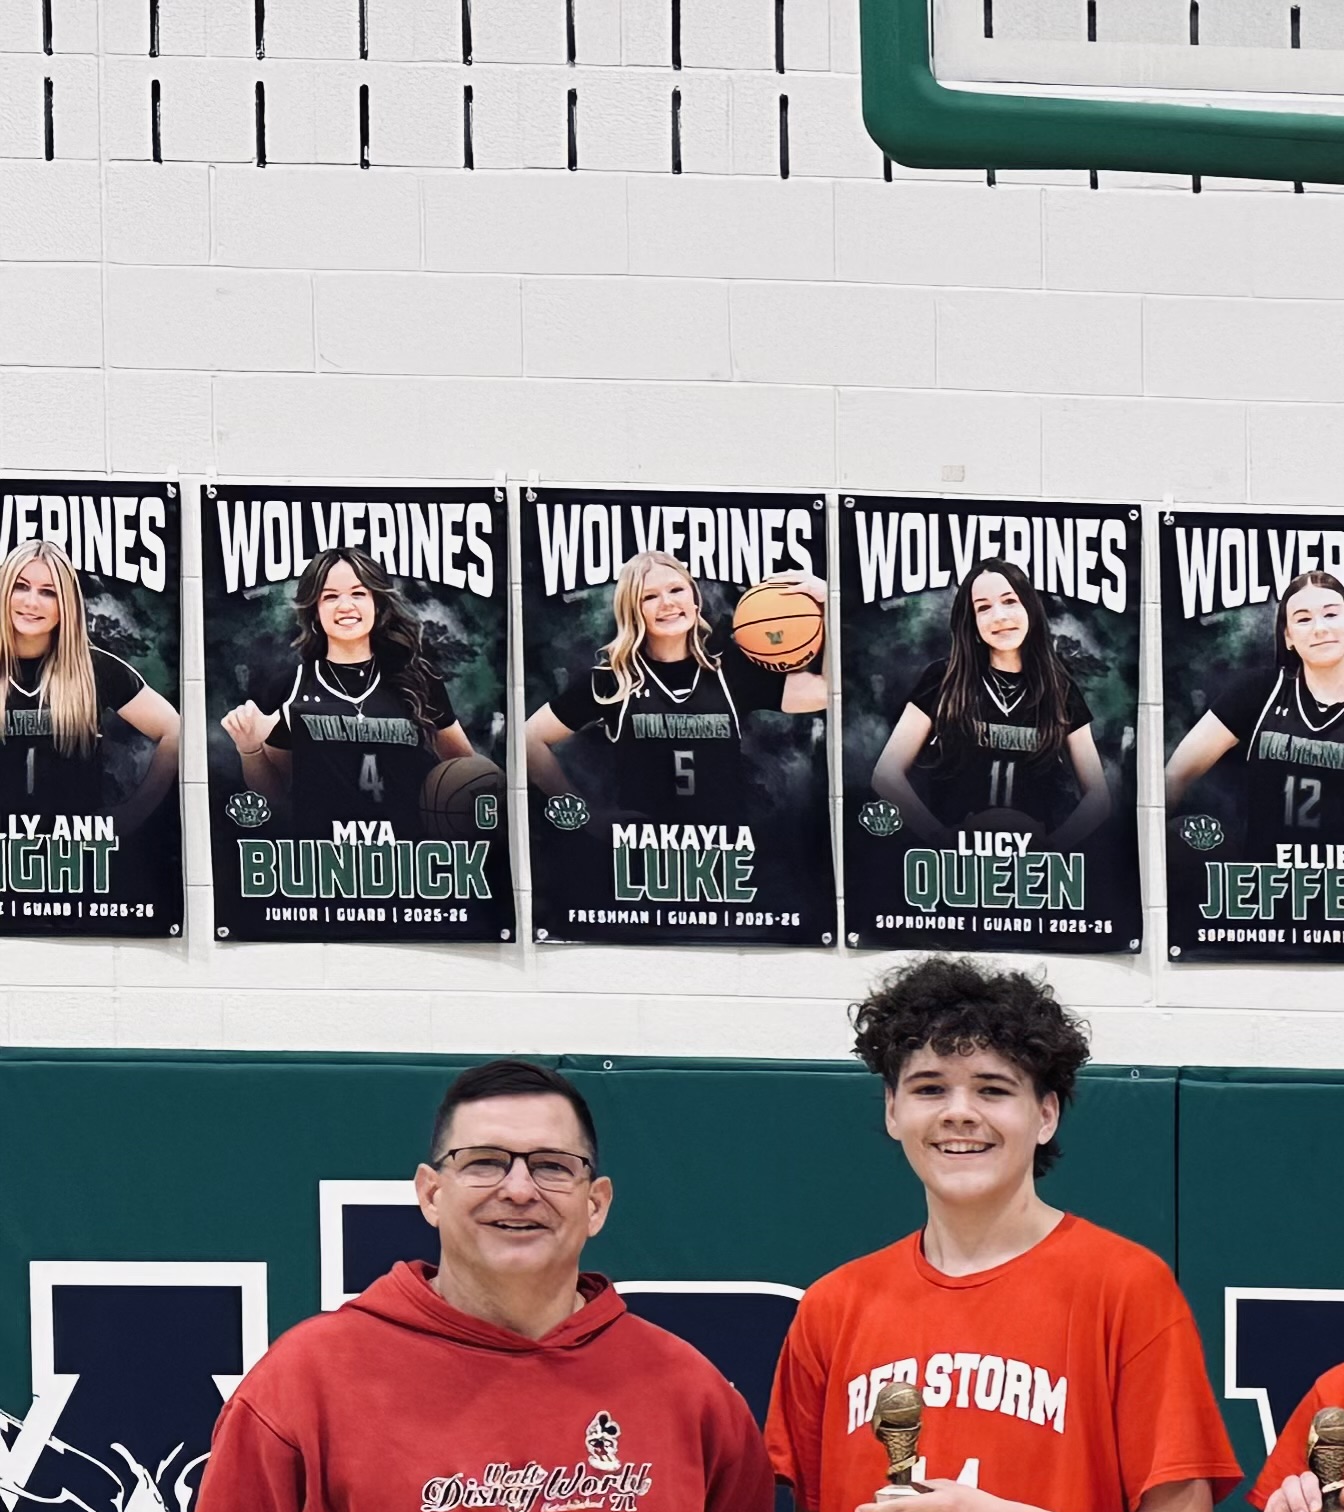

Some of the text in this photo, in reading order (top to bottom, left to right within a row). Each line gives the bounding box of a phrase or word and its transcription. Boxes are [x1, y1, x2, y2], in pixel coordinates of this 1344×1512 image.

[216, 501, 495, 598] WOLVERINES
[537, 503, 813, 596] WOLVERINES
[855, 511, 1127, 613] WOLVERINES
[359, 754, 384, 801] 4
[673, 750, 696, 796] 5
[989, 761, 1015, 806] 11
[1284, 775, 1322, 827] 12
[53, 816, 114, 841] ANN
[332, 820, 396, 846] MYA
[613, 824, 755, 850] MAKAYLA
[959, 830, 1032, 858] LUCY
[237, 839, 492, 899] BUNDICK
[613, 844, 757, 902] LUKE
[904, 848, 1085, 912] QUEEN
[23, 903, 155, 918] GUARD 2025-26
[266, 907, 468, 922] JUNIOR GUARD 2025-26
[569, 909, 800, 927] FRESHMAN GUARD 2025-26
[876, 915, 1113, 934] SOPHOMORE GUARD 2025-26
[1198, 928, 1286, 943] SOPHOMORE
[922, 1353, 1068, 1434] STORM
[545, 1462, 652, 1500] World
